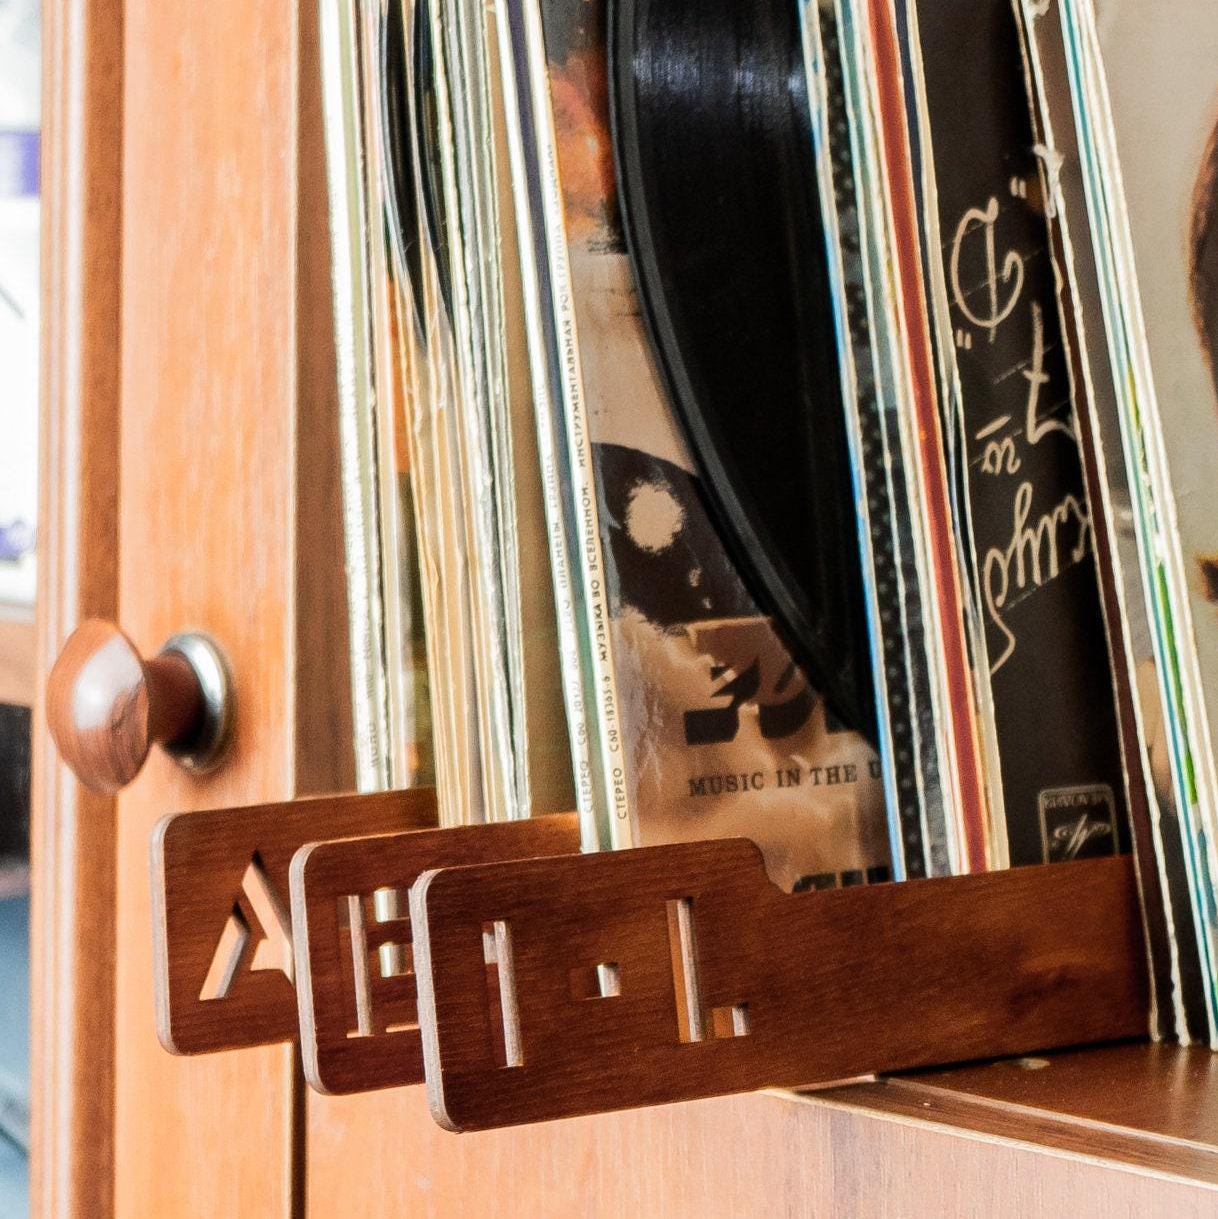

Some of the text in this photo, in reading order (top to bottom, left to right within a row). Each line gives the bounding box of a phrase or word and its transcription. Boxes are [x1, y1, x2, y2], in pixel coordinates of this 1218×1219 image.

[565, 318, 585, 468] ИНСТРУМЕНТАЛЬНАЯ
[592, 578, 600, 599] ВО
[594, 602, 608, 662] МУЗЫКА
[581, 759, 592, 814] СТЕРЕО
[614, 766, 626, 820] СТЕРЕО
[688, 772, 765, 797] MUSIC
[776, 768, 801, 788] IN
[809, 763, 858, 785] THE
[199, 850, 297, 1001] A
